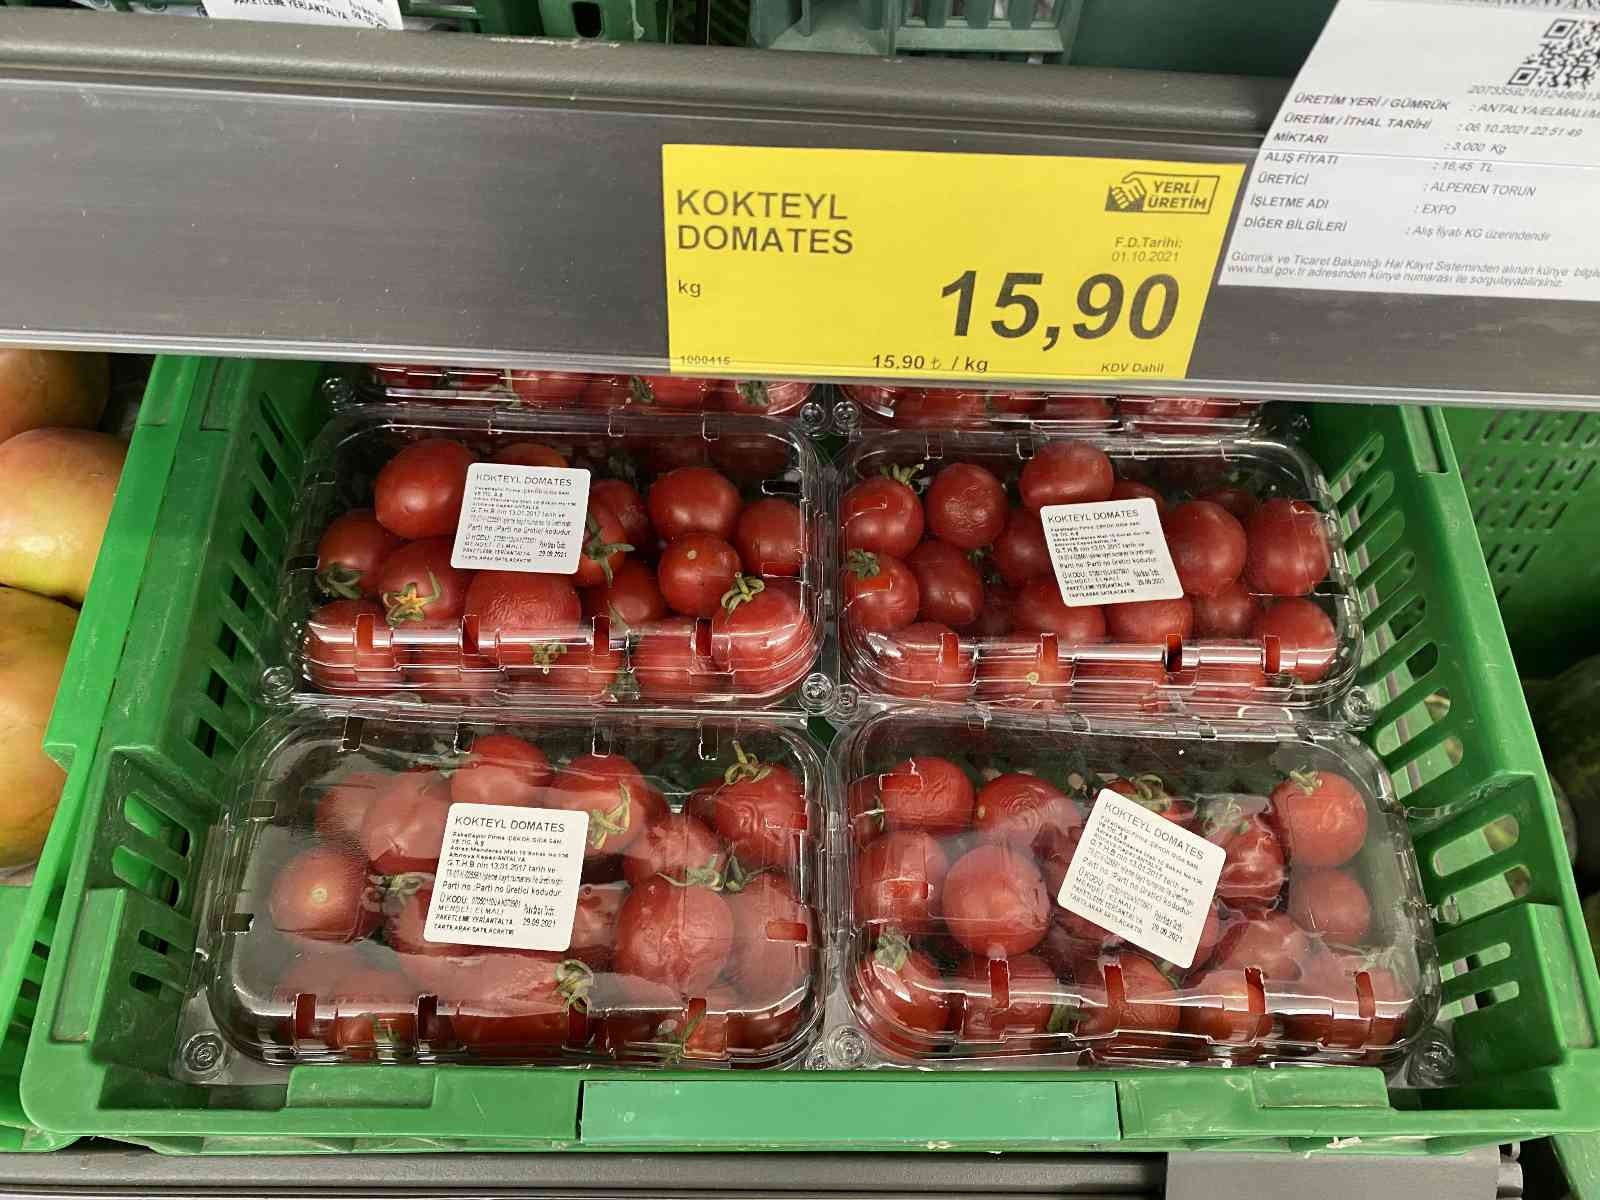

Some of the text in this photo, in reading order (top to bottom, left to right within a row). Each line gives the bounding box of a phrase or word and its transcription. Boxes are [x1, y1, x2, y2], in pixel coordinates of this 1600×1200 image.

[1293, 91, 1345, 104] ÜRETİM
[1349, 94, 1383, 107] YERİ
[1390, 95, 1451, 111] GÜMRÜK
[1283, 111, 1335, 125] ÜRETİM
[1273, 131, 1329, 144] MİKTARI
[1264, 151, 1339, 165] ALIŞ FİYATI
[1153, 179, 1200, 194] YERLİ
[1430, 181, 1489, 195] ALPEREN
[1491, 183, 1537, 197] TORUN
[676, 188, 848, 220] KOKTEYL
[1147, 194, 1208, 209] ÜRETİM
[1249, 193, 1329, 209] İŞLETME ADI
[1421, 203, 1457, 216] EXPO
[677, 224, 854, 254] DOMATES
[1464, 227, 1483, 239] KG
[1111, 250, 1179, 262] 01.10.2021
[1278, 255, 1290, 264] ve
[1294, 254, 1333, 266] Ticaret
[678, 279, 701, 297] kg
[940, 269, 1179, 351] 15,90
[964, 356, 989, 373] kg
[1100, 362, 1165, 373] KDV Dahil
[476, 474, 572, 486] KOKTEYL DOMATES
[1048, 509, 1138, 524] KOKTEYL DOMATES
[455, 817, 566, 832] KOKTEYL DOMATES
[1104, 802, 1153, 833] KOKTEYL
[1154, 827, 1205, 860] DOMATES
